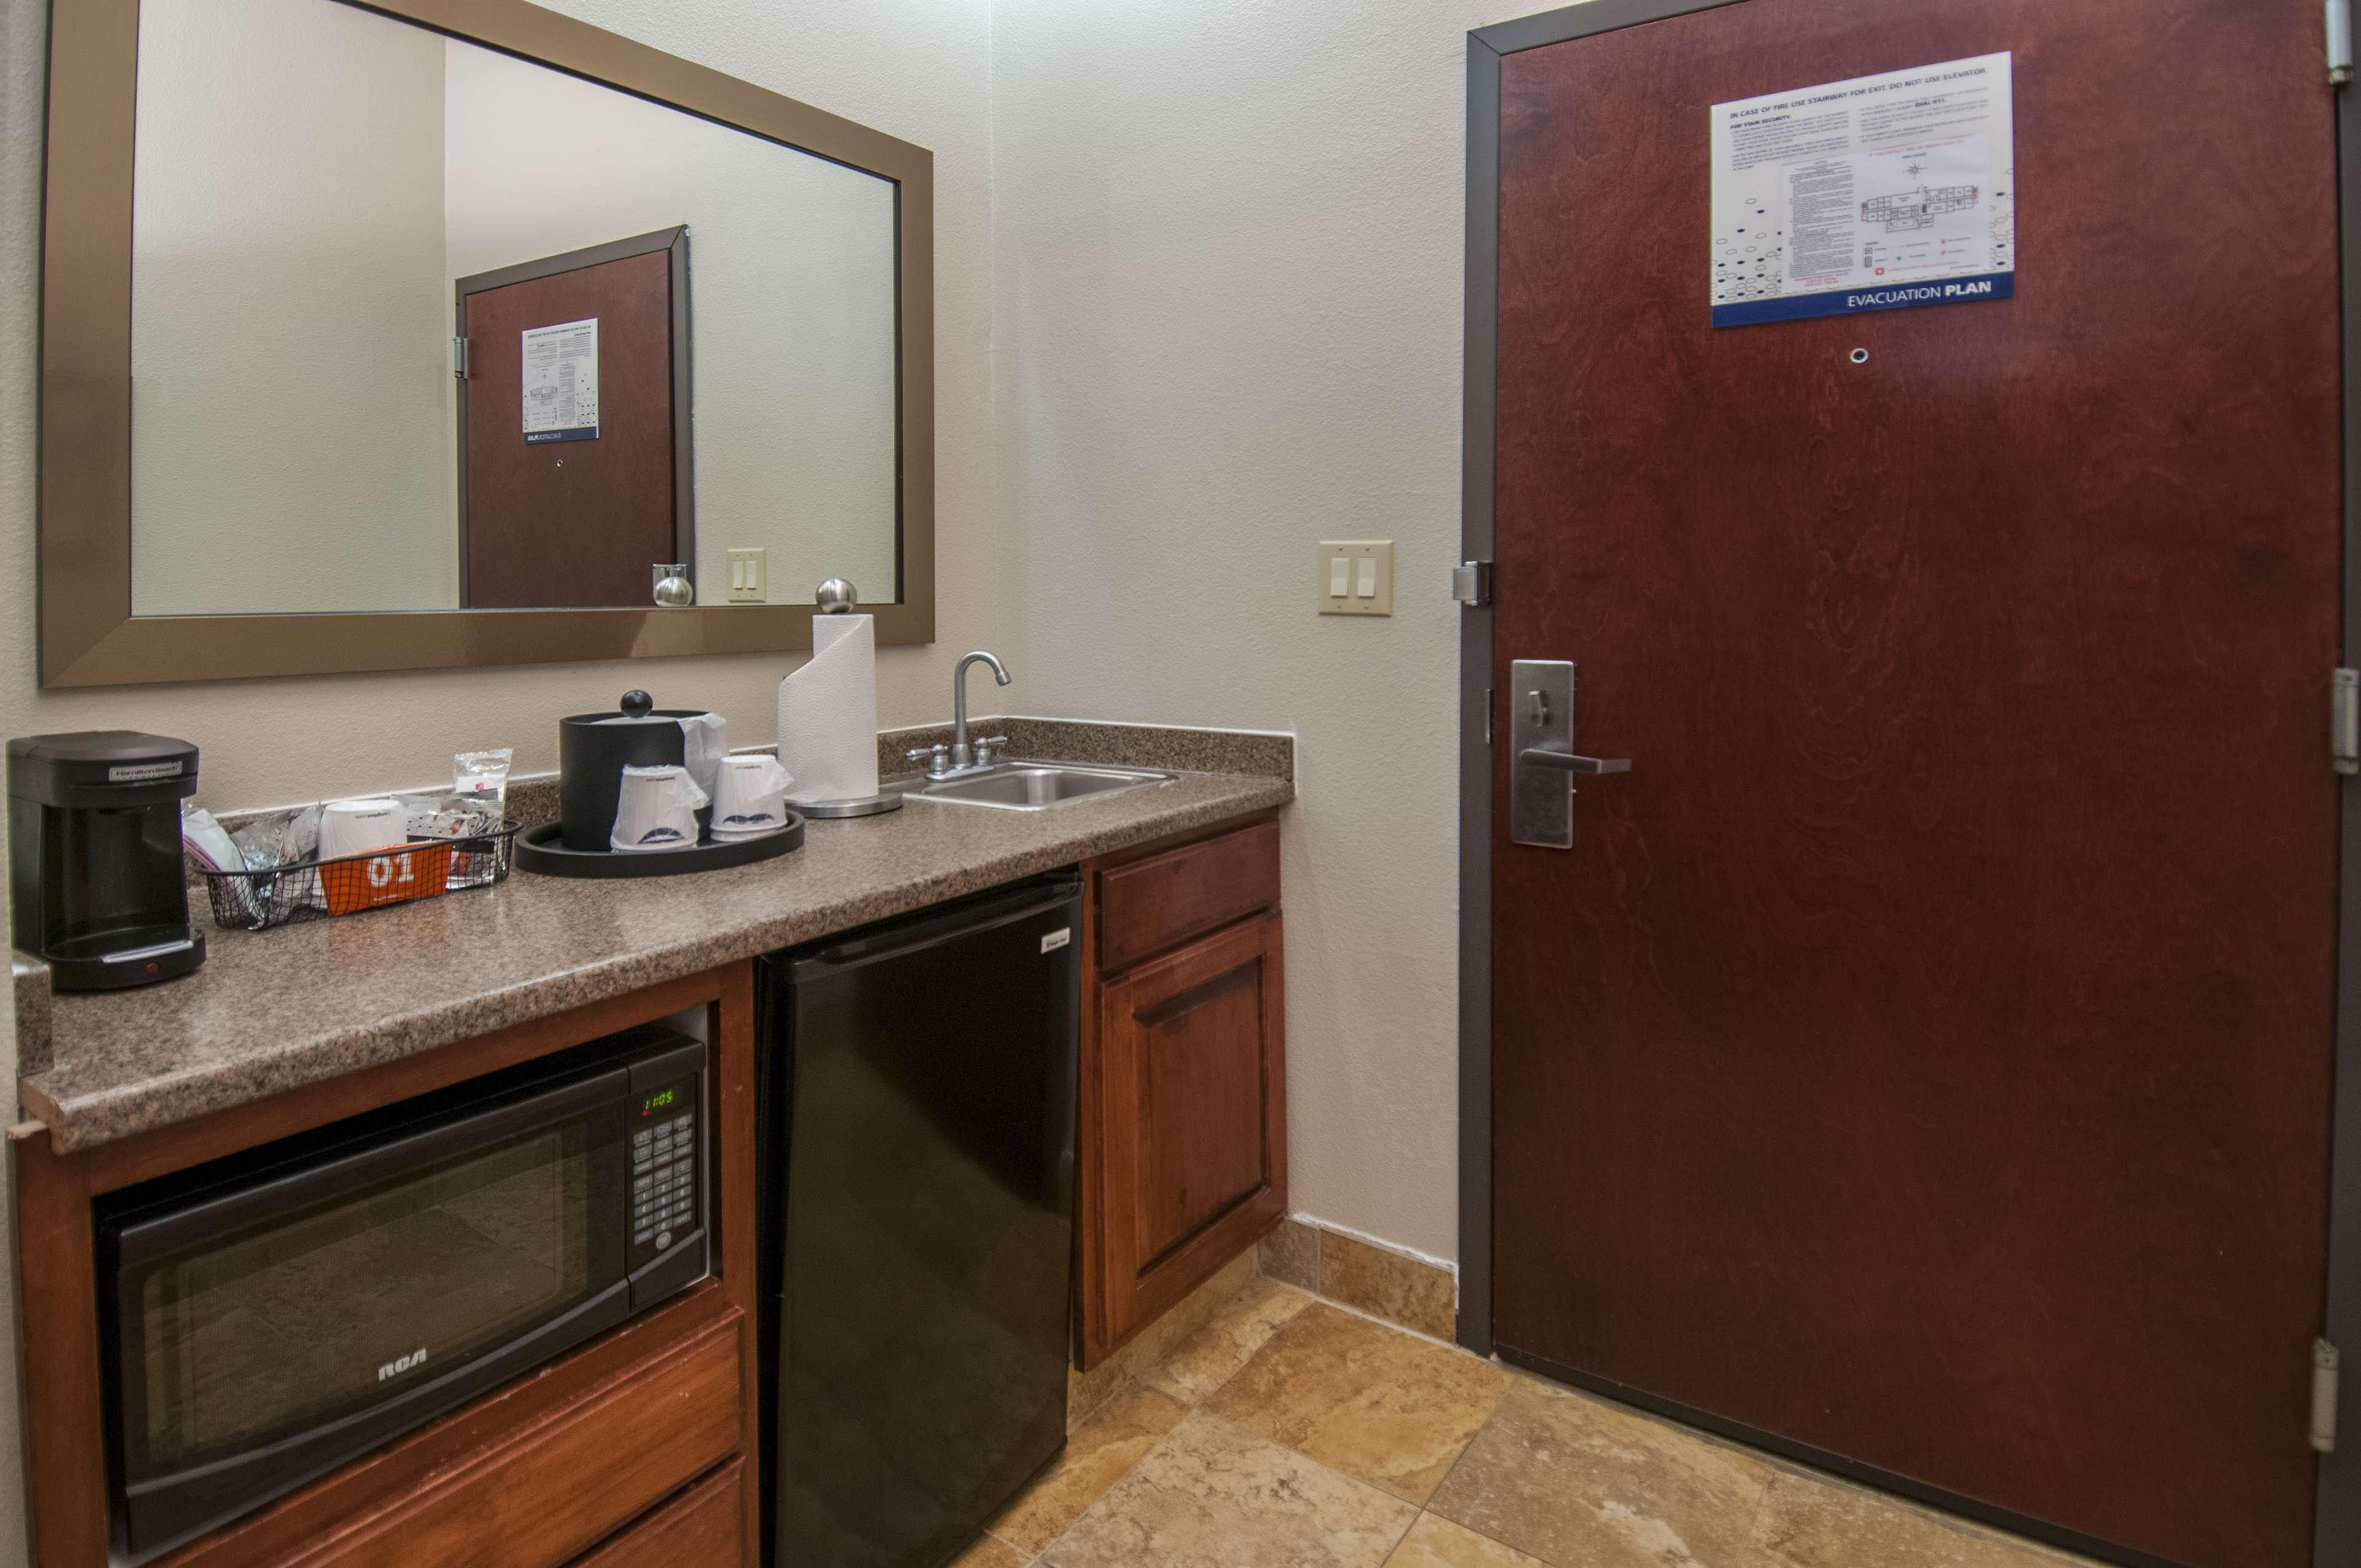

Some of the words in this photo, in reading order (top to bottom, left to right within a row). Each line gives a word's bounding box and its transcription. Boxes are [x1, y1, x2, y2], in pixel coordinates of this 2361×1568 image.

[1808, 92, 1847, 105] STAIRWAY
[1905, 78, 1923, 87] NOT
[1925, 74, 1941, 83] USE
[1847, 287, 1942, 307] EVACUATION
[1945, 280, 1992, 297] PLAN
[367, 852, 415, 887] 01
[645, 1090, 673, 1110] 11:05
[378, 1348, 426, 1382] RCA
